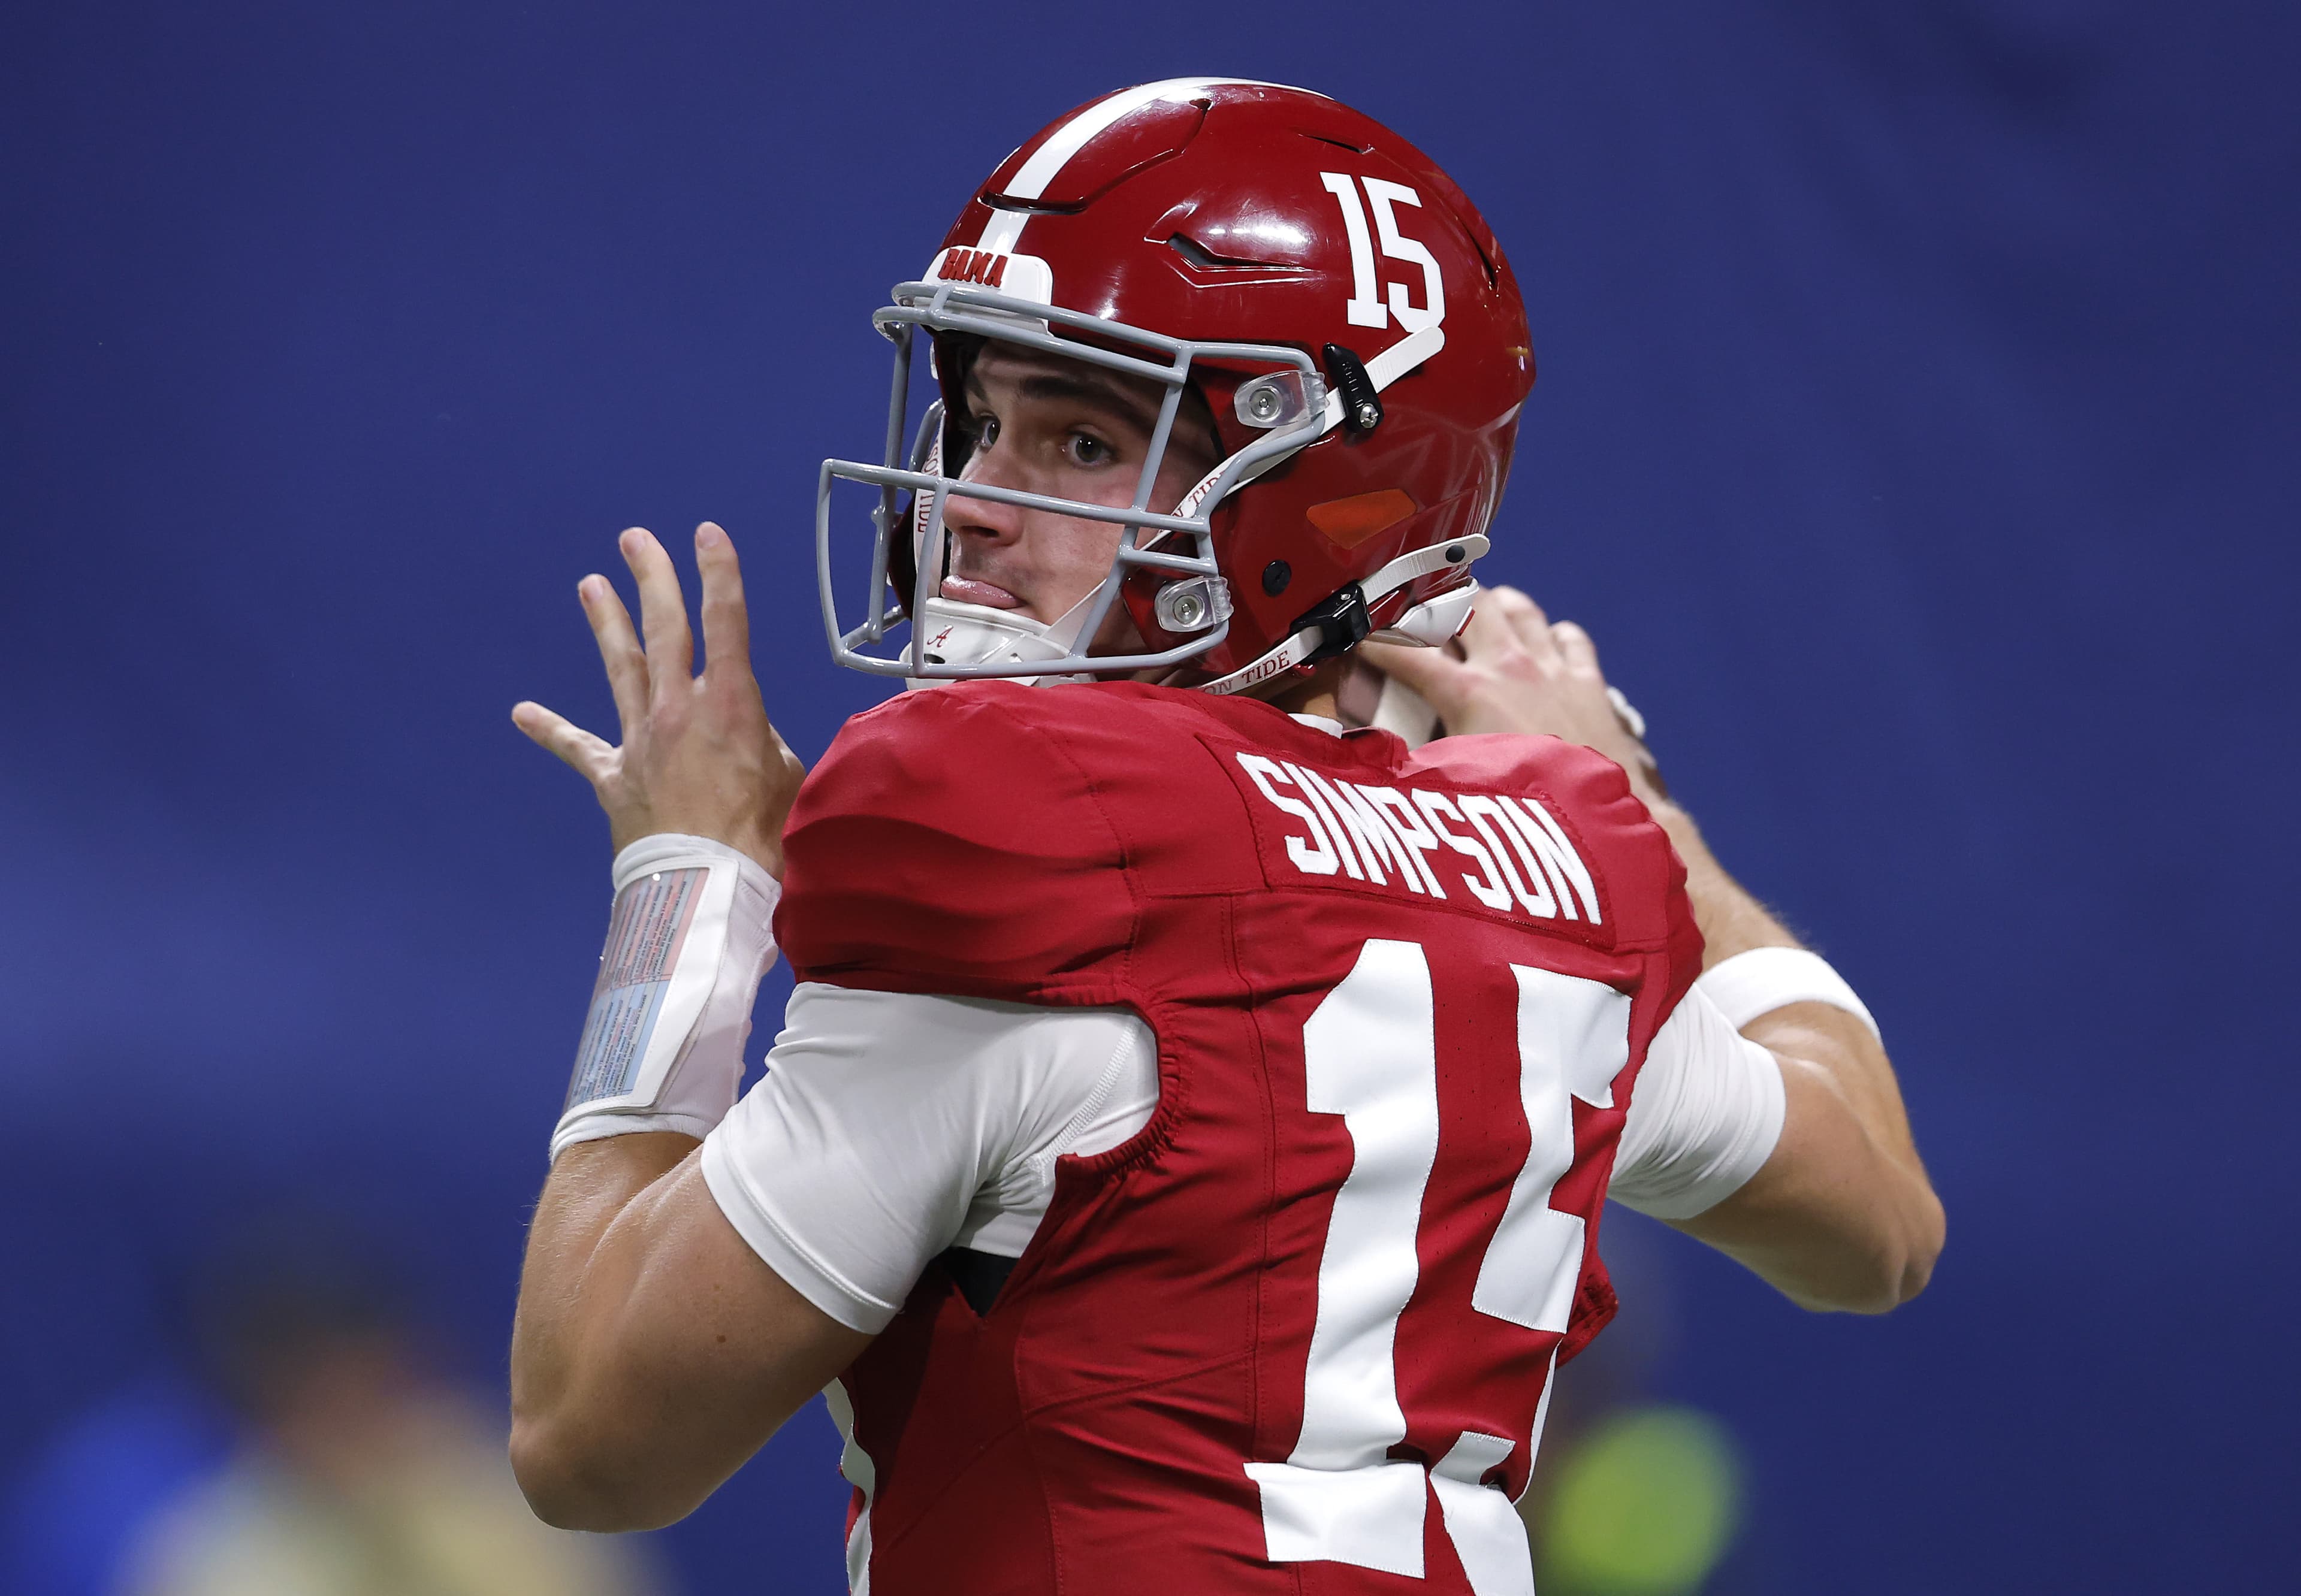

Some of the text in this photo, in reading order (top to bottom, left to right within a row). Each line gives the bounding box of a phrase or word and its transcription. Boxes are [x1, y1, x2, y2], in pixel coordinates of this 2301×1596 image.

[937, 248, 1008, 288] BAMA
[1319, 171, 1445, 334] 15
[926, 624, 954, 648] A
[1241, 650, 1291, 684] TIDE
[1236, 751, 1602, 926] SIMPSON
[1243, 938, 1633, 1596] 15
